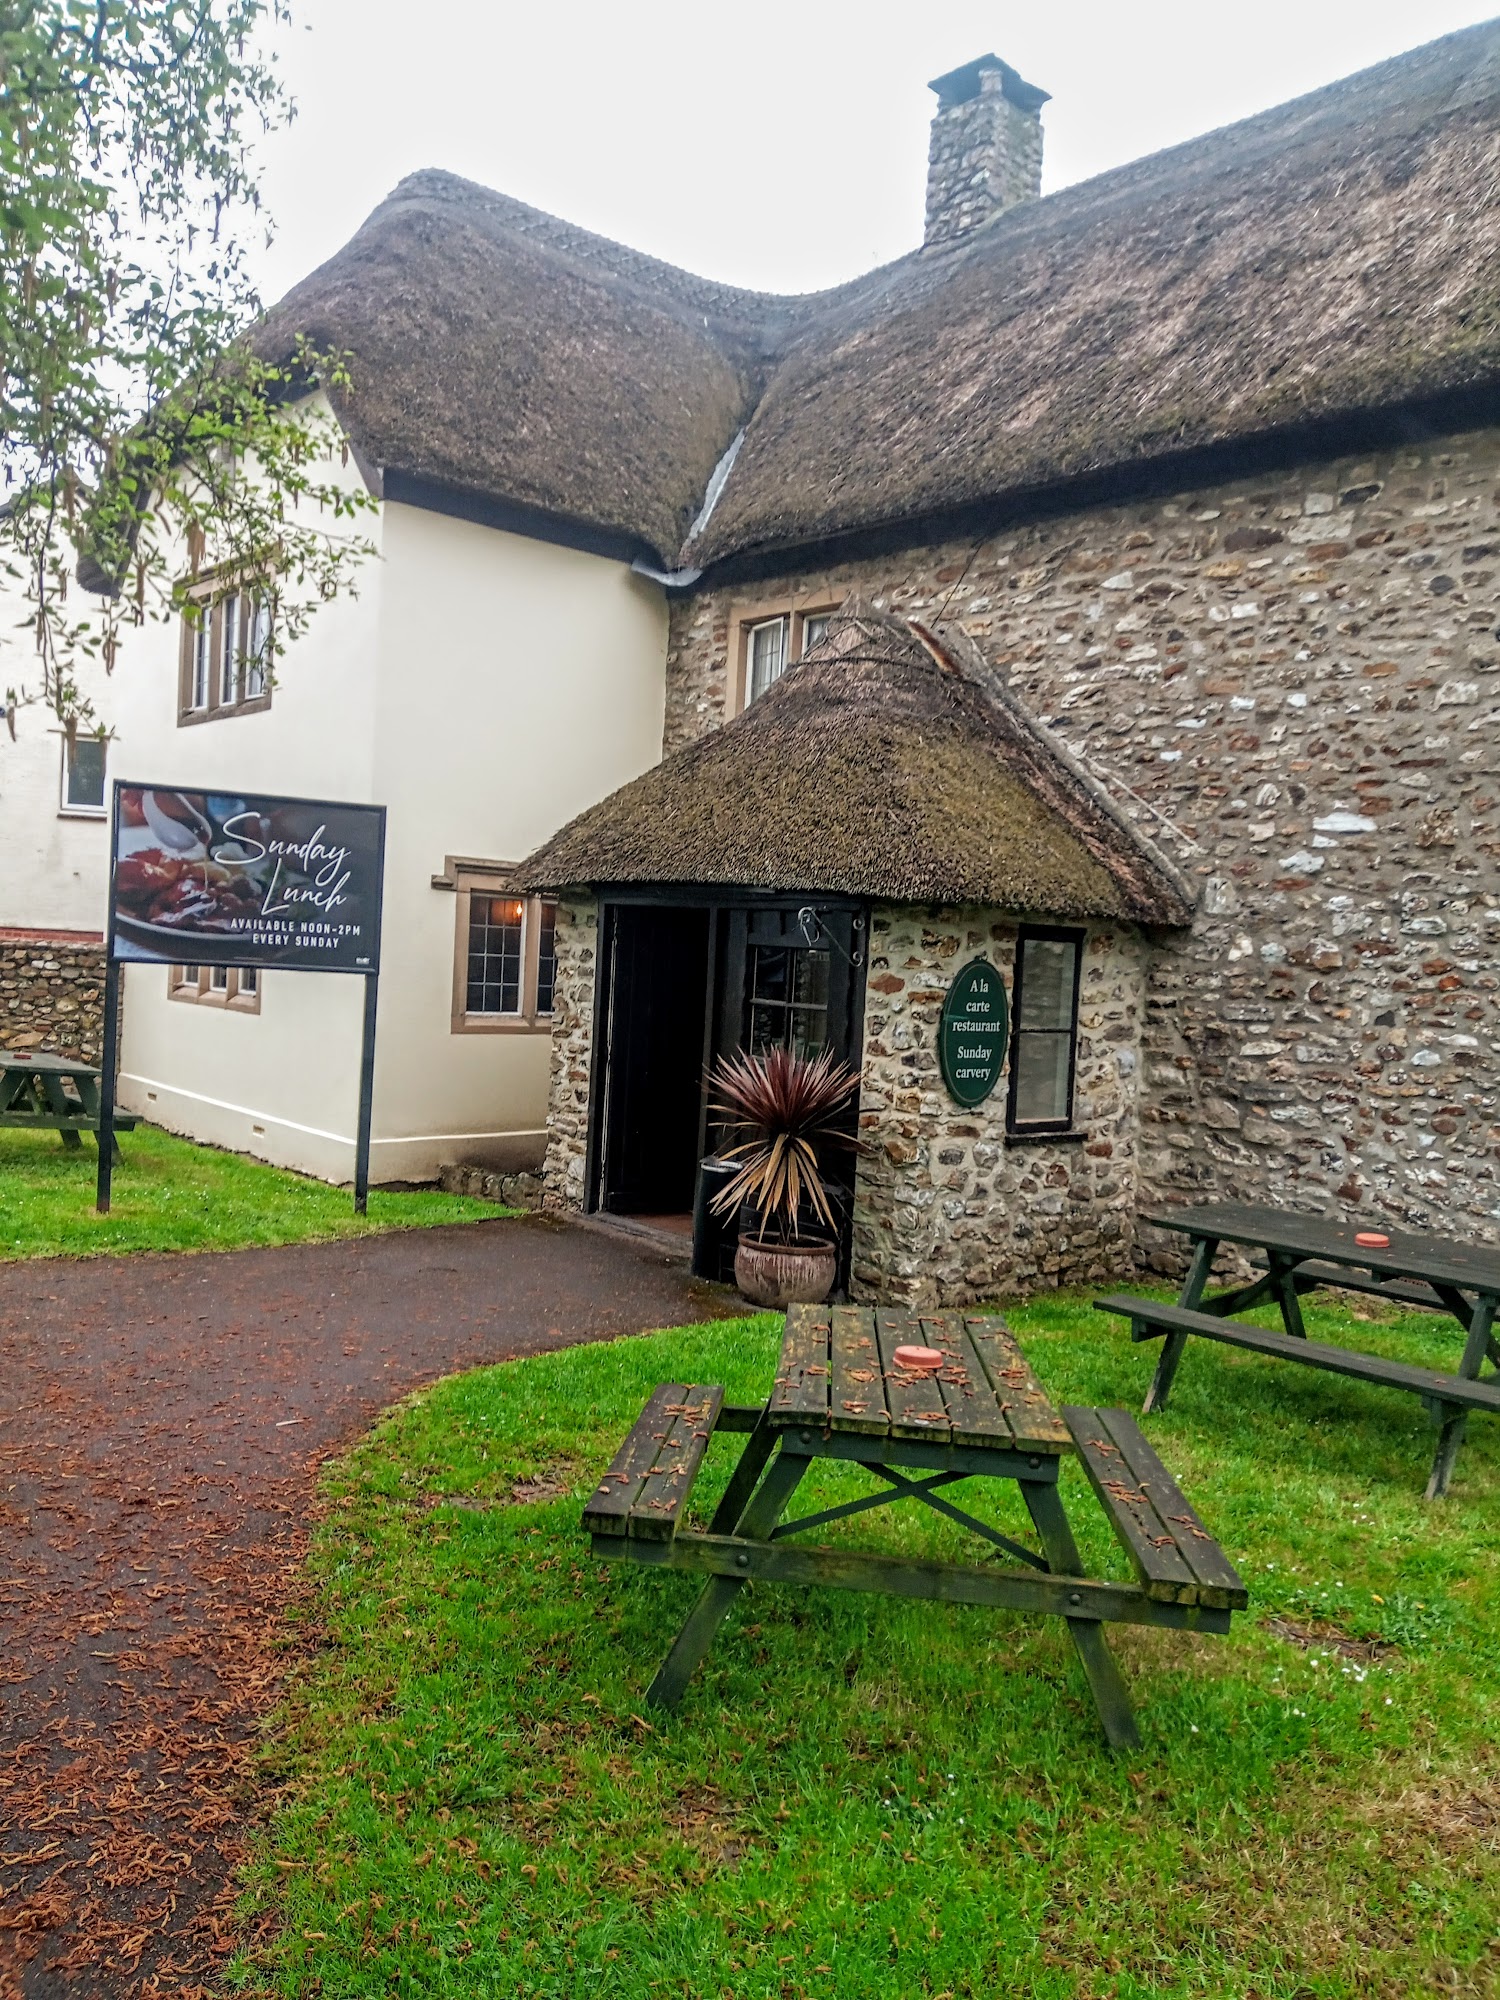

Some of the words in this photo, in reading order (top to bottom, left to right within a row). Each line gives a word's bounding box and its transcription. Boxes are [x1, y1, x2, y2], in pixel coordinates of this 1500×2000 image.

[214, 811, 351, 886] Sunday
[261, 858, 351, 916] Lunch
[231, 918, 294, 932] AVAILABLE
[301, 921, 360, 936] NOON-2PM
[253, 933, 289, 946] EVERY
[295, 935, 339, 948] SUNDAY
[970, 981, 978, 993] A
[980, 979, 989, 993] la
[966, 1001, 990, 1012] carte
[952, 1020, 1000, 1032] restaurant
[957, 1045, 992, 1061] Sunday
[956, 1068, 991, 1081] carvery
